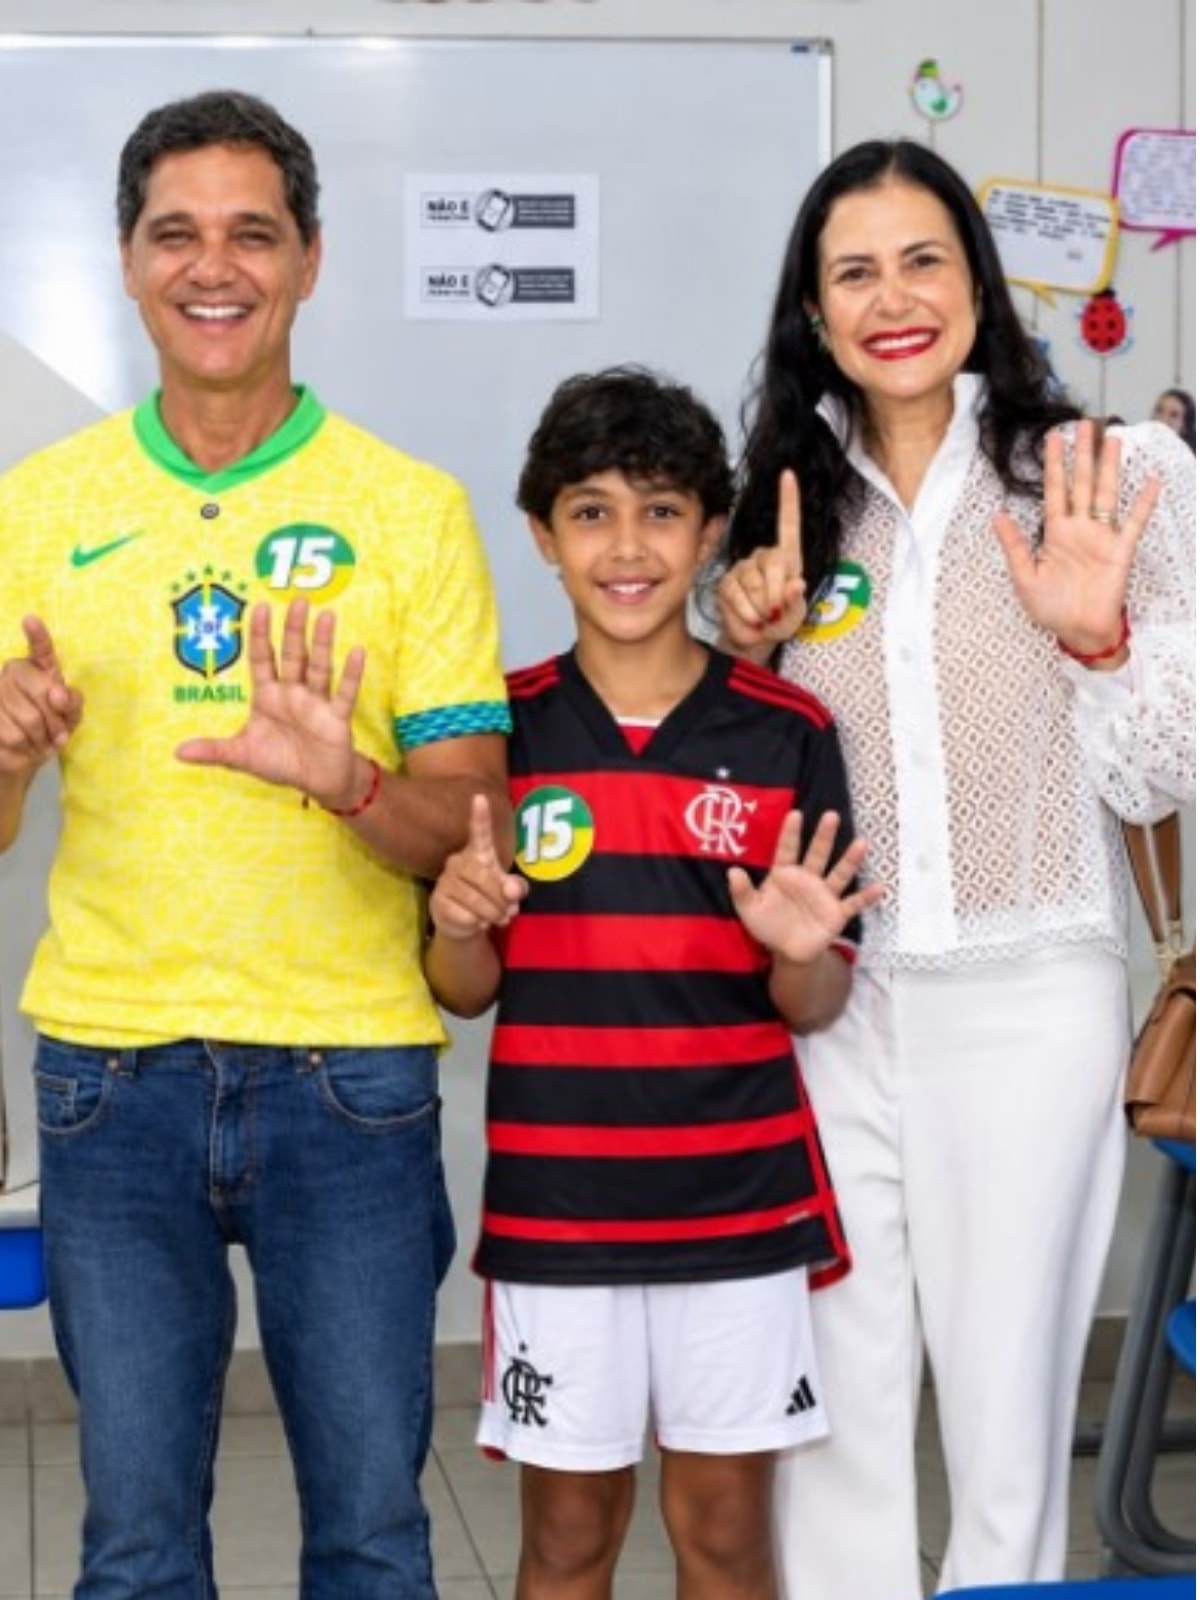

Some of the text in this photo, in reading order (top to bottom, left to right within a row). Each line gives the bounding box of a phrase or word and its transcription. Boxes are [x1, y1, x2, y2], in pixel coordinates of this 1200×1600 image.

[268, 536, 336, 589] 15
[174, 686, 246, 702] BRASIL
[521, 798, 574, 864] 15
